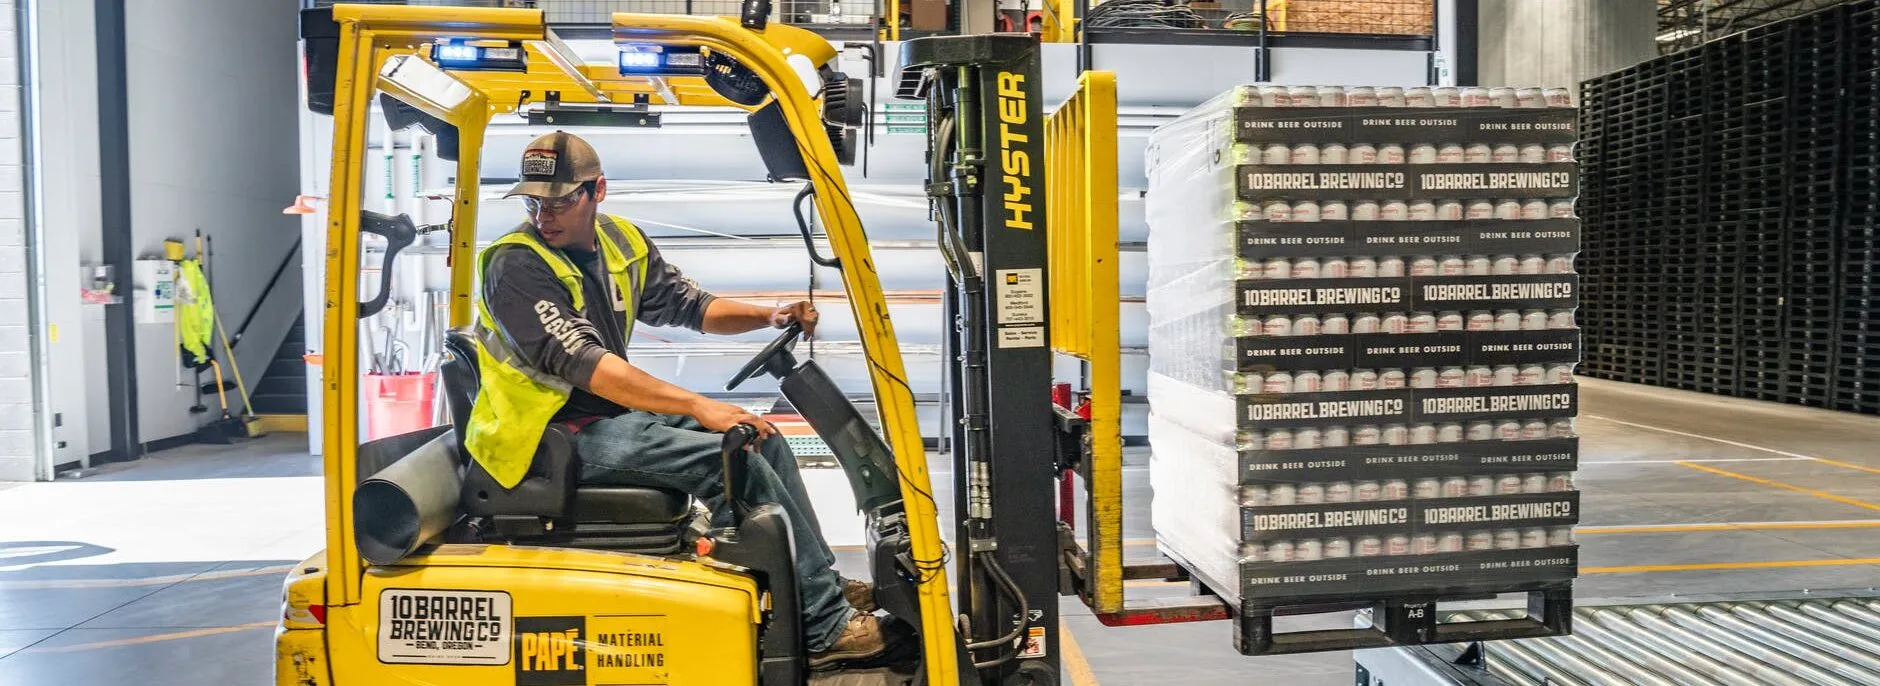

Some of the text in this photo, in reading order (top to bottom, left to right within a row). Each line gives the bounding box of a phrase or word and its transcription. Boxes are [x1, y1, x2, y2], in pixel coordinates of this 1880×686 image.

[1245, 121, 1342, 129] DRINK BEER OUTSIDE
[1363, 118, 1391, 126] DRINK
[1395, 118, 1416, 126] BEER
[1511, 122, 1531, 130] BEER
[1535, 122, 1571, 130] OUTSIDE
[997, 71, 1033, 230] HYSTER
[1248, 236, 1344, 245] DRINK BEER OUTSIDE
[1367, 235, 1460, 244] DRINK BEER OUTSIDE
[1511, 231, 1531, 239] BEER
[1535, 231, 1570, 239] OUTSIDE
[1247, 346, 1344, 357] DRINK BEER OUTSIDE
[1367, 345, 1460, 355] DRINK BEER OUTSIDE
[1482, 342, 1572, 352] DRINK BEER OUTSIDE
[1366, 453, 1458, 464] DRINK BEER OUTSIDE
[1481, 453, 1570, 464] DRINK BEER OUTSIDE
[1249, 460, 1345, 471] DRINK BEER OUTSIDE
[1480, 557, 1568, 570] DRINK BEER OUTSIDE
[1367, 564, 1459, 576] DRINK BEER OUTSIDE
[1251, 573, 1346, 585] DRINK BEER OUTSIDE
[390, 620, 500, 641] BREWING CO
[442, 642, 473, 650] OREGON
[597, 654, 664, 668] HANDLING
